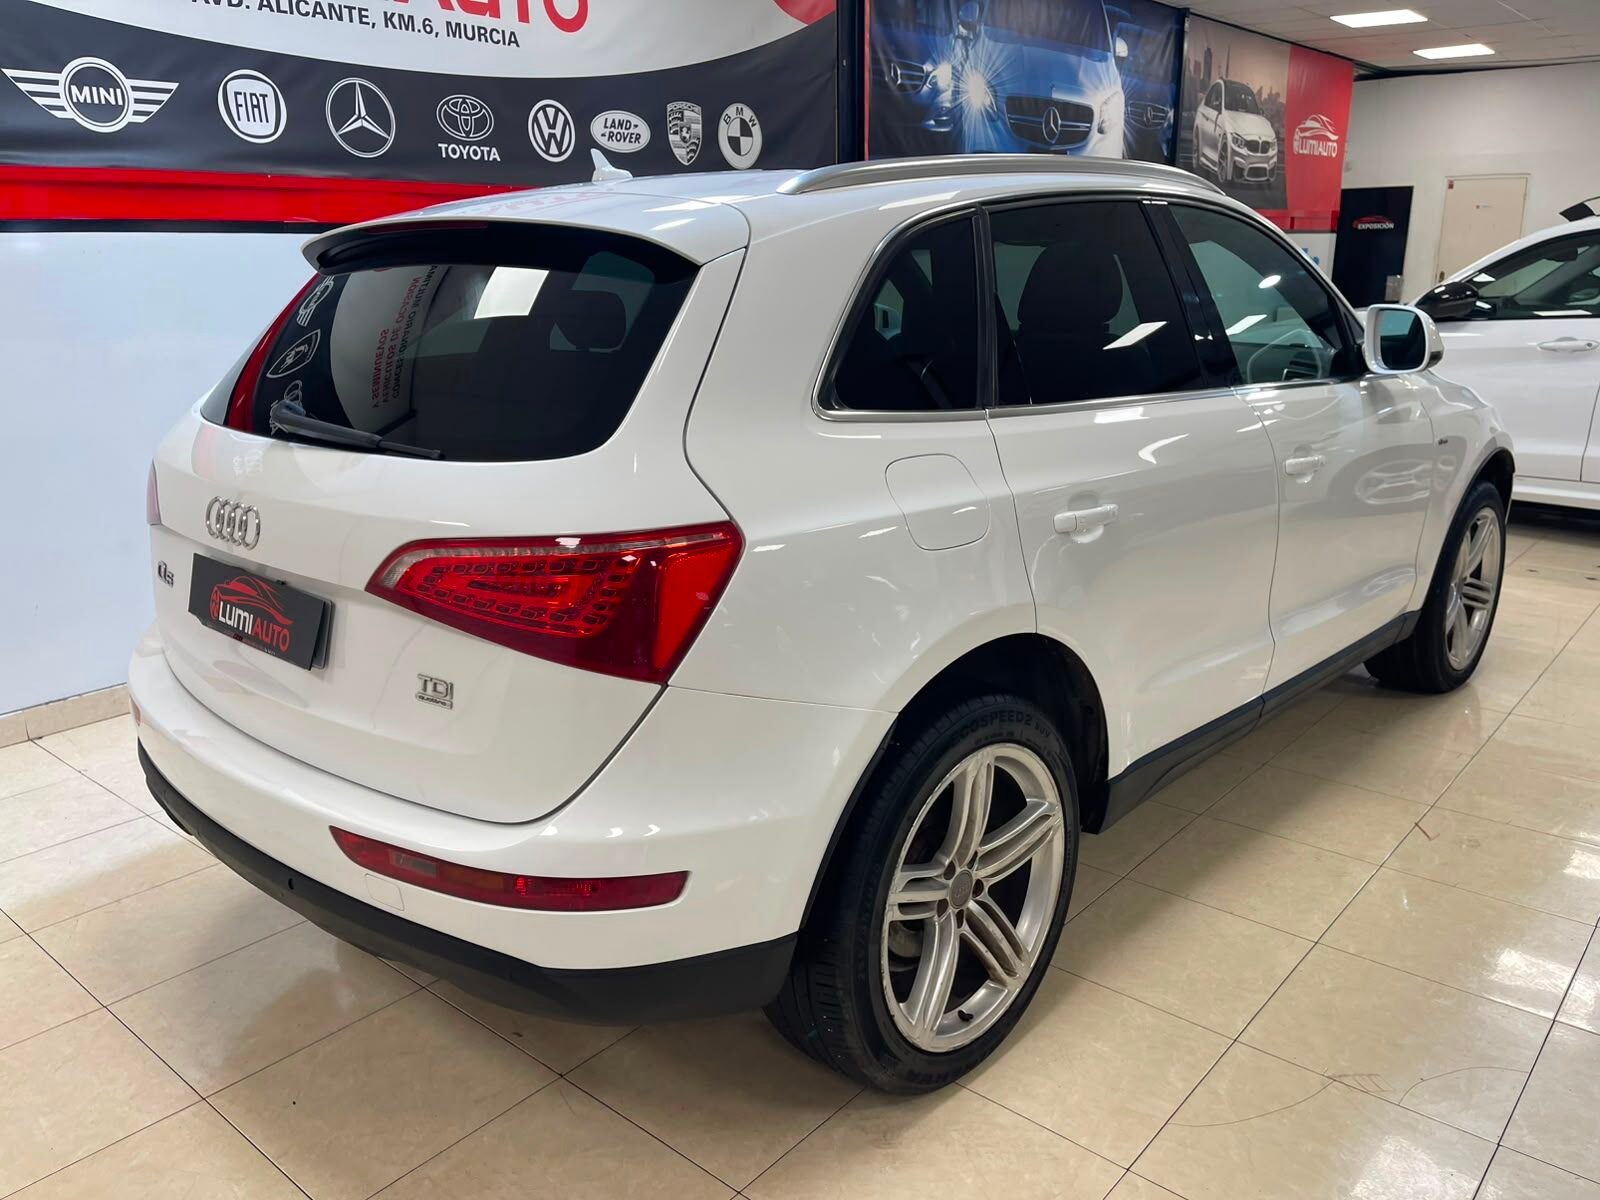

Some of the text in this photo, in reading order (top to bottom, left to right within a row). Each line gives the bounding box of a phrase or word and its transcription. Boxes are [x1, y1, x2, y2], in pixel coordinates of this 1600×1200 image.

[257, 0, 377, 29] ALICANTE,
[383, 11, 440, 38] KM.6,
[445, 21, 521, 48] MURCIA
[70, 85, 124, 106] MINI
[234, 91, 270, 123] FIAT
[722, 106, 758, 128] BMW
[607, 131, 641, 144] ROVER
[438, 143, 501, 162] TOYOTA
[417, 673, 454, 701] TDI
